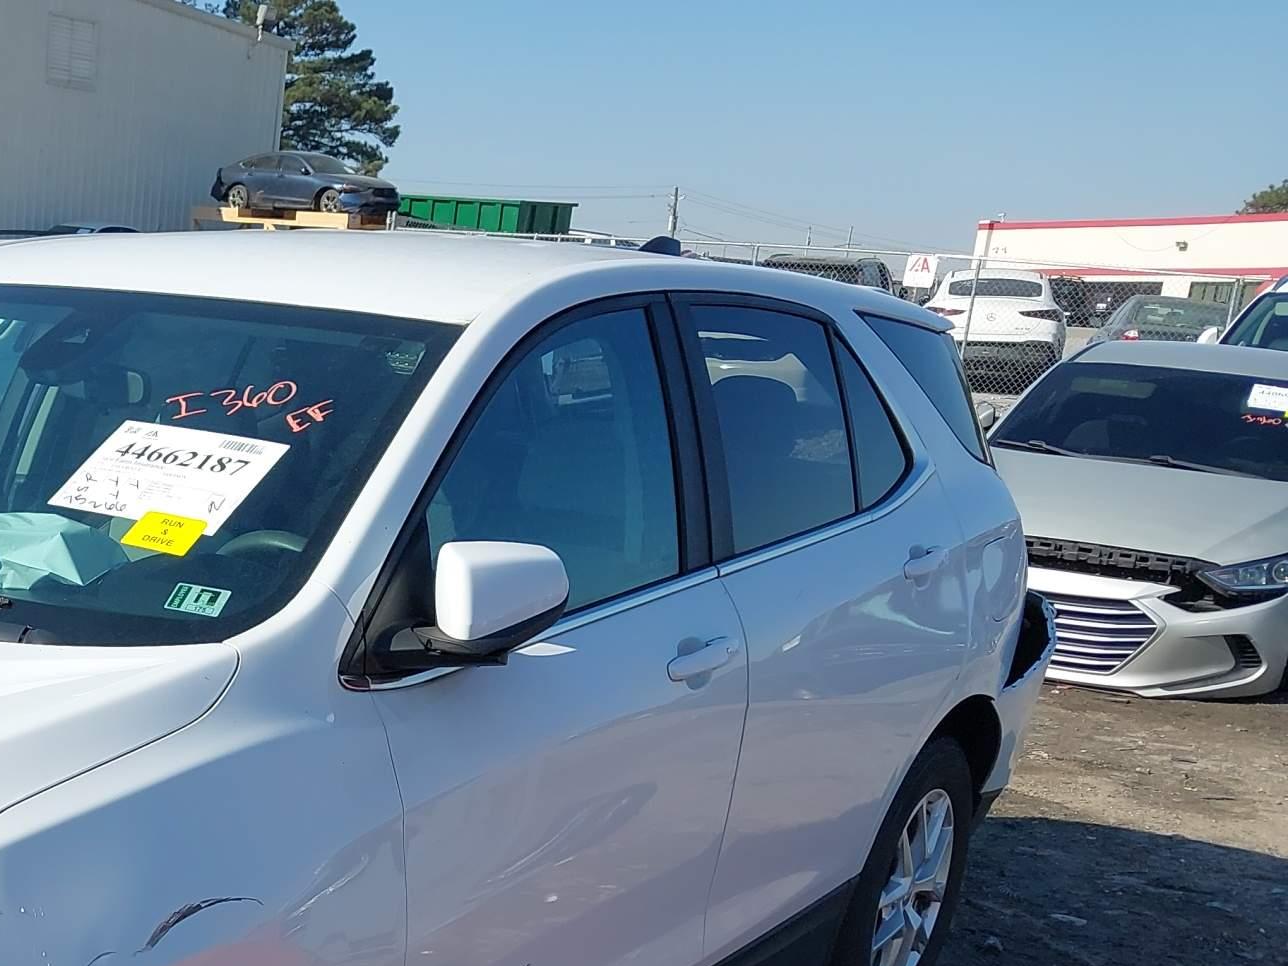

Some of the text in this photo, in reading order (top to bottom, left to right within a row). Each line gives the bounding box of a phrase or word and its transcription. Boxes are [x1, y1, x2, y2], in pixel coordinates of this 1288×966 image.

[115, 442, 251, 477] 44662187
[161, 518, 185, 529] RUN
[141, 534, 175, 547] DRIVE
